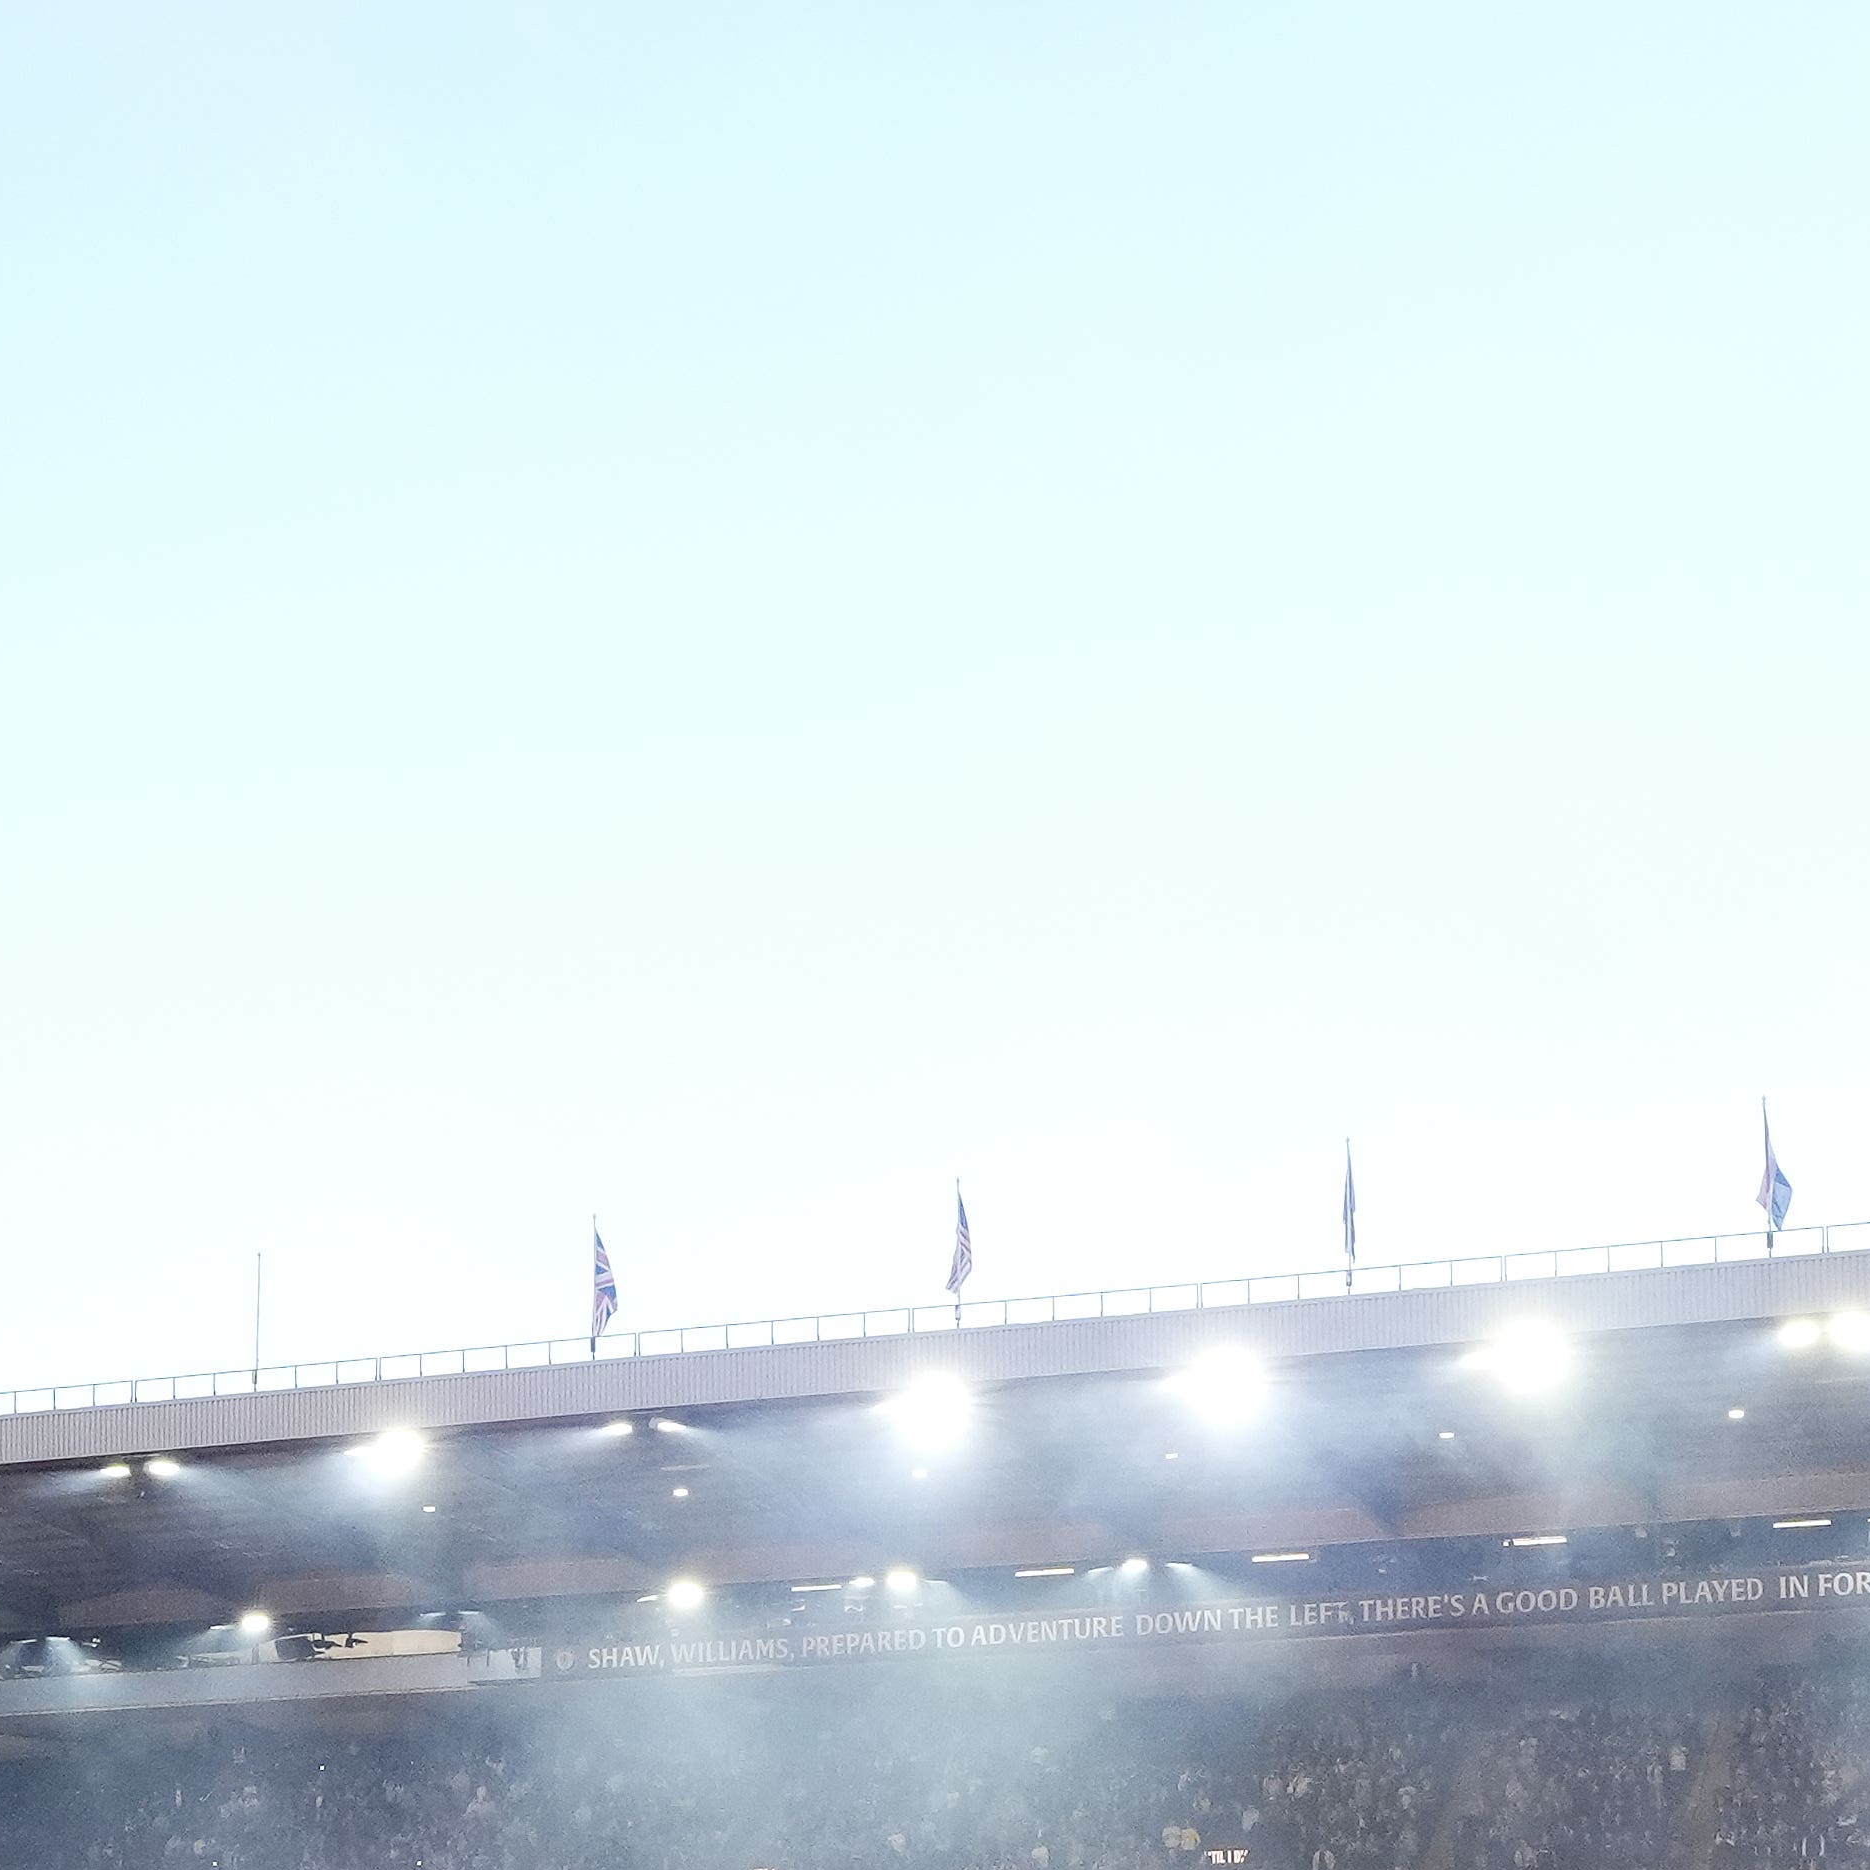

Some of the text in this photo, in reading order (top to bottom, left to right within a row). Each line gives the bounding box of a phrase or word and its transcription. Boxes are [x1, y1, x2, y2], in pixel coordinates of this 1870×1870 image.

[588, 1646, 665, 1670] SHAW,
[670, 1638, 795, 1664] WILLIAMS,
[800, 1630, 927, 1658] PREPARED
[932, 1626, 966, 1649] TO
[971, 1616, 1125, 1647] ADVENTURE
[1136, 1608, 1222, 1636] DOWN
[1228, 1605, 1280, 1630] THE
[1359, 1594, 1466, 1623] THERE'S
[1471, 1593, 1490, 1615] A
[1495, 1588, 1579, 1613] GOOD
[1588, 1584, 1656, 1610] BALL
[1661, 1577, 1764, 1606] PLAYED
[1779, 1574, 1809, 1599] IN
